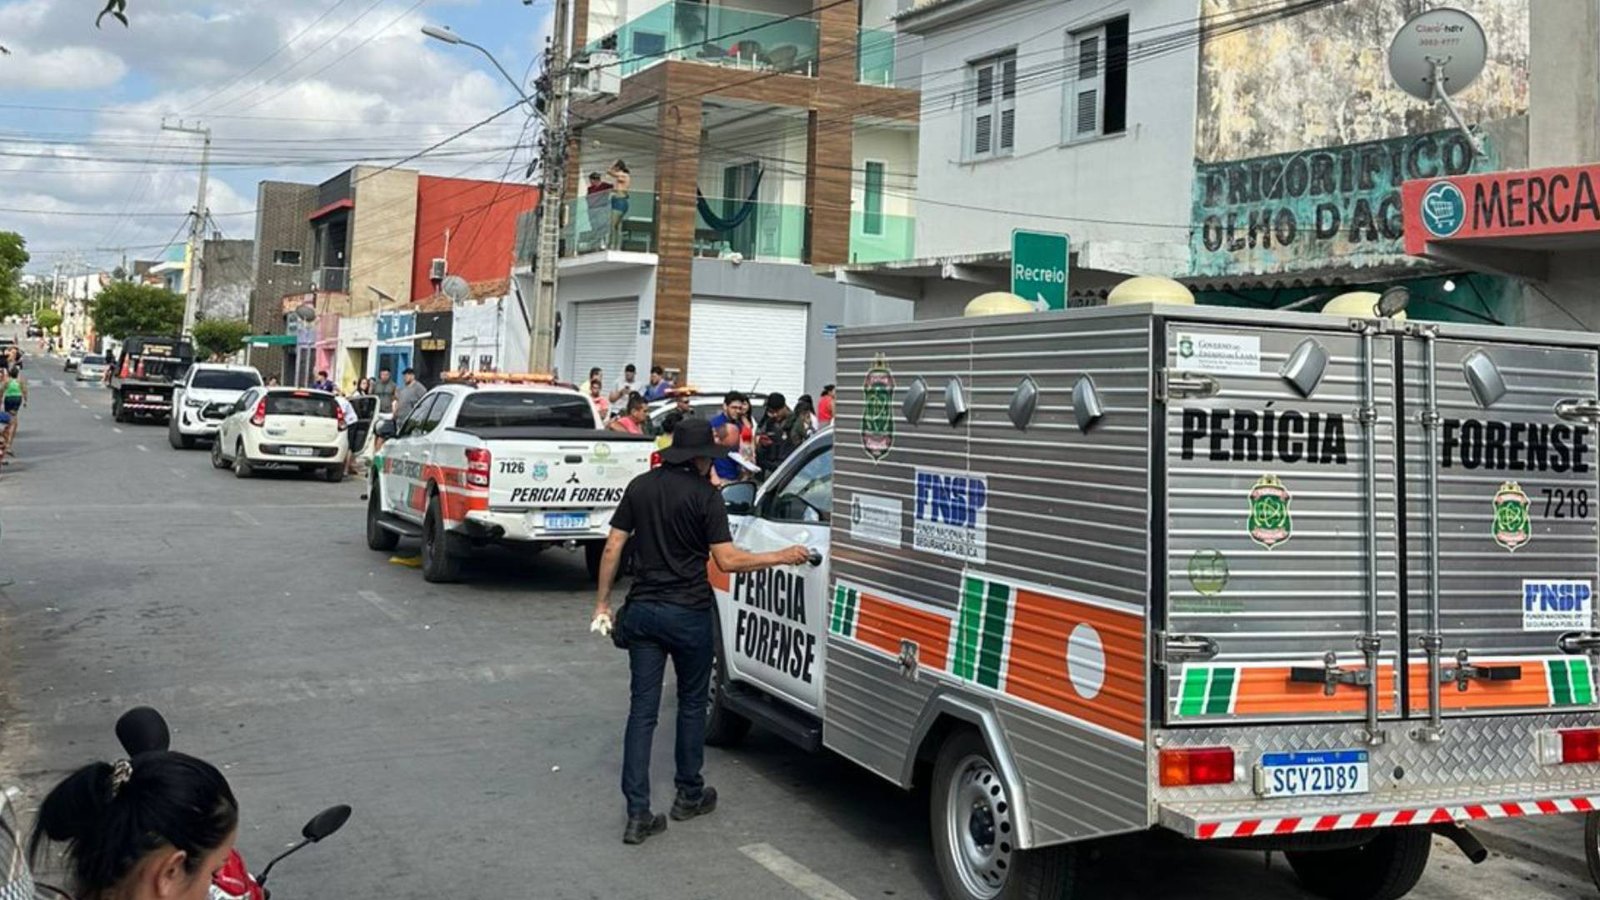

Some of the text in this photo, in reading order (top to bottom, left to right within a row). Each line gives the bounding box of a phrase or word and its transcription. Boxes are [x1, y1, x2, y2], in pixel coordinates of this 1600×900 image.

[1472, 171, 1600, 230] MERCA
[1202, 193, 1404, 252] OLHO D'AG
[1015, 264, 1065, 284] Recreio
[1182, 401, 1347, 464] PERÍCIA
[1442, 419, 1589, 473] FORENSE
[500, 461, 525, 474] 7126
[510, 487, 624, 503] PERICIA FORENS
[917, 473, 986, 530] FNSP
[1541, 488, 1588, 518] 7218
[1525, 584, 1590, 612] FNSP
[735, 608, 816, 684] FORENSE
[1273, 765, 1358, 793] SCY2D89
